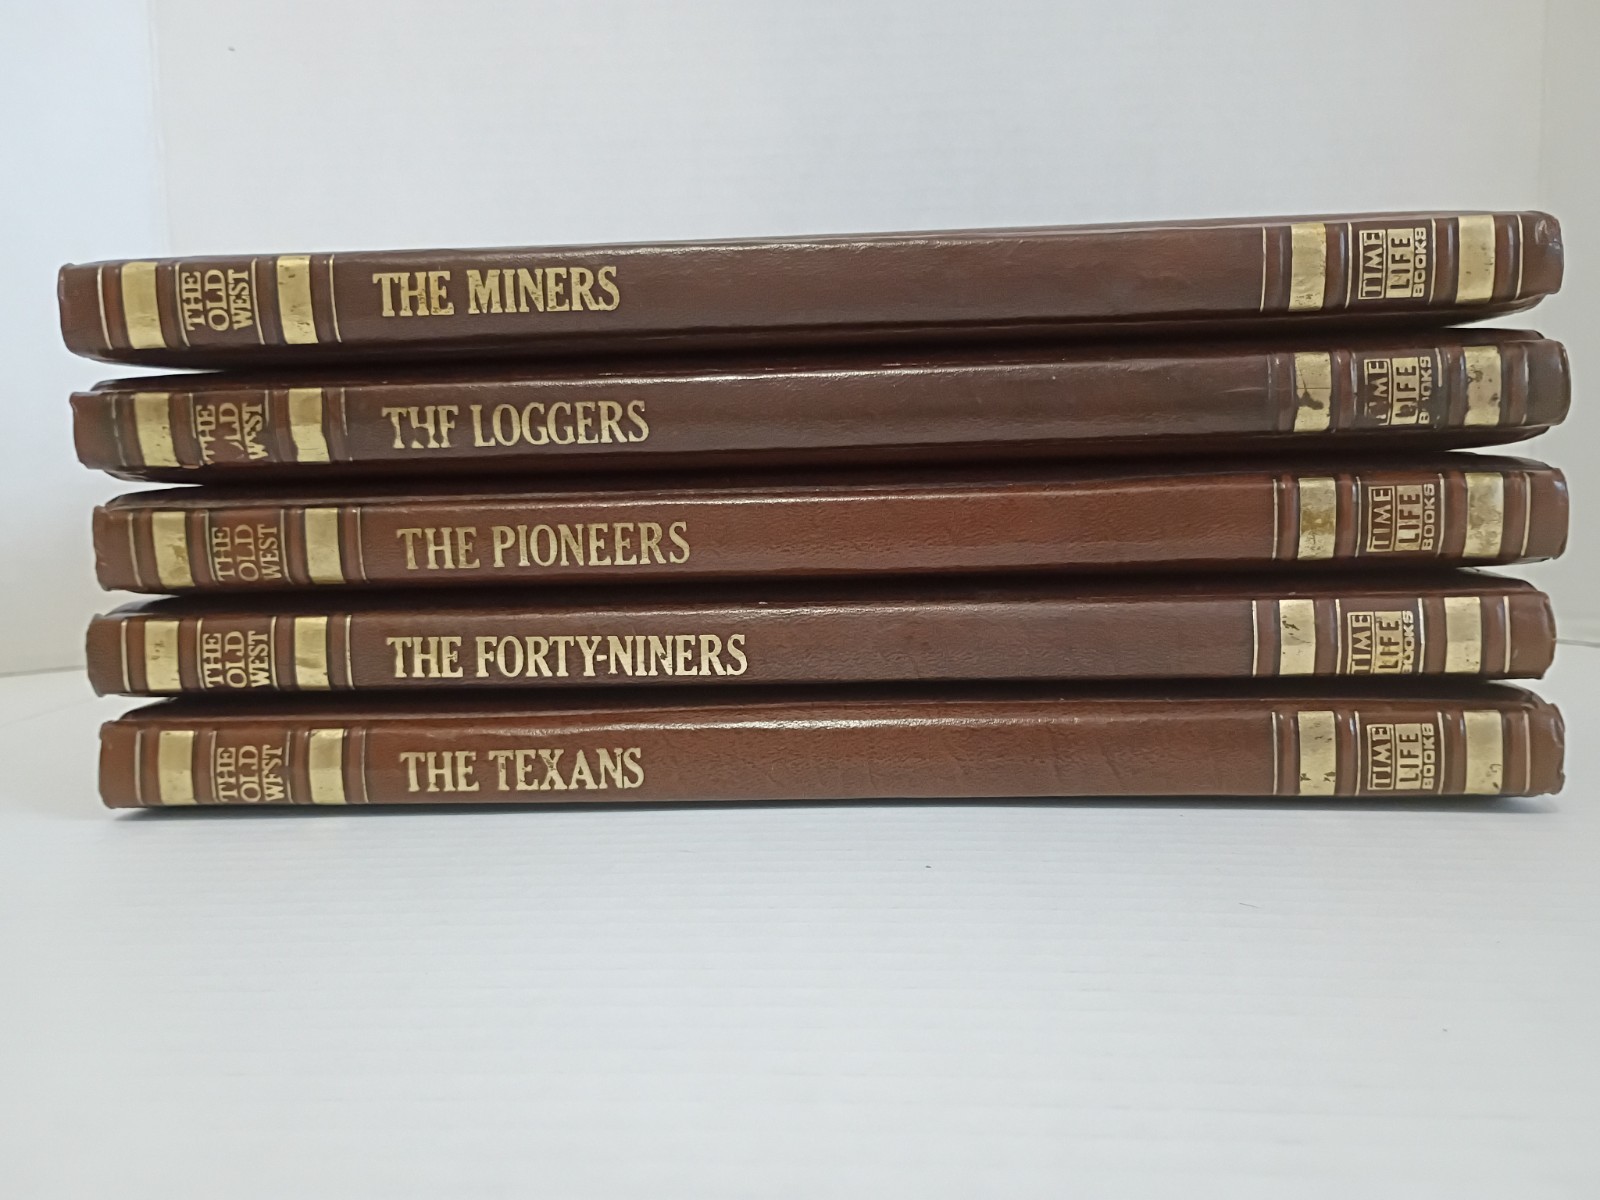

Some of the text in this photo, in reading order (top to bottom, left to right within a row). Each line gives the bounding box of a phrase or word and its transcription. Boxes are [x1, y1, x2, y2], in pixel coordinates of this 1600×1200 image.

[372, 265, 620, 317] THE MINERS
[1362, 231, 1383, 297] TIME
[1388, 236, 1412, 291] LIFE
[1412, 227, 1427, 298] BOOKS
[181, 270, 206, 331] THE
[204, 269, 230, 331] OLD
[227, 268, 254, 330] WEST
[196, 404, 216, 464] THE
[470, 400, 649, 447] LOGGERS
[396, 521, 691, 570] THE PIONEERS
[1372, 488, 1392, 551] TIME
[1397, 493, 1421, 544] LIFE
[1421, 483, 1435, 551] BOOKS
[211, 526, 236, 582] THE
[235, 524, 259, 582] OLD
[257, 523, 282, 580] WEST
[202, 632, 225, 688] THE
[224, 630, 248, 689] OLD
[247, 630, 271, 688] WEST
[386, 634, 748, 679] THE FORTY-NINERS
[1351, 614, 1372, 674] TIME
[1377, 619, 1401, 670] LIFE
[216, 746, 239, 802] THE
[238, 744, 261, 803] OLD
[261, 743, 285, 802] WEST
[400, 747, 645, 792] THE TEXANS
[1371, 725, 1392, 789] TIME
[1397, 731, 1420, 784] LIFE
[1421, 722, 1436, 790] BOOKS
